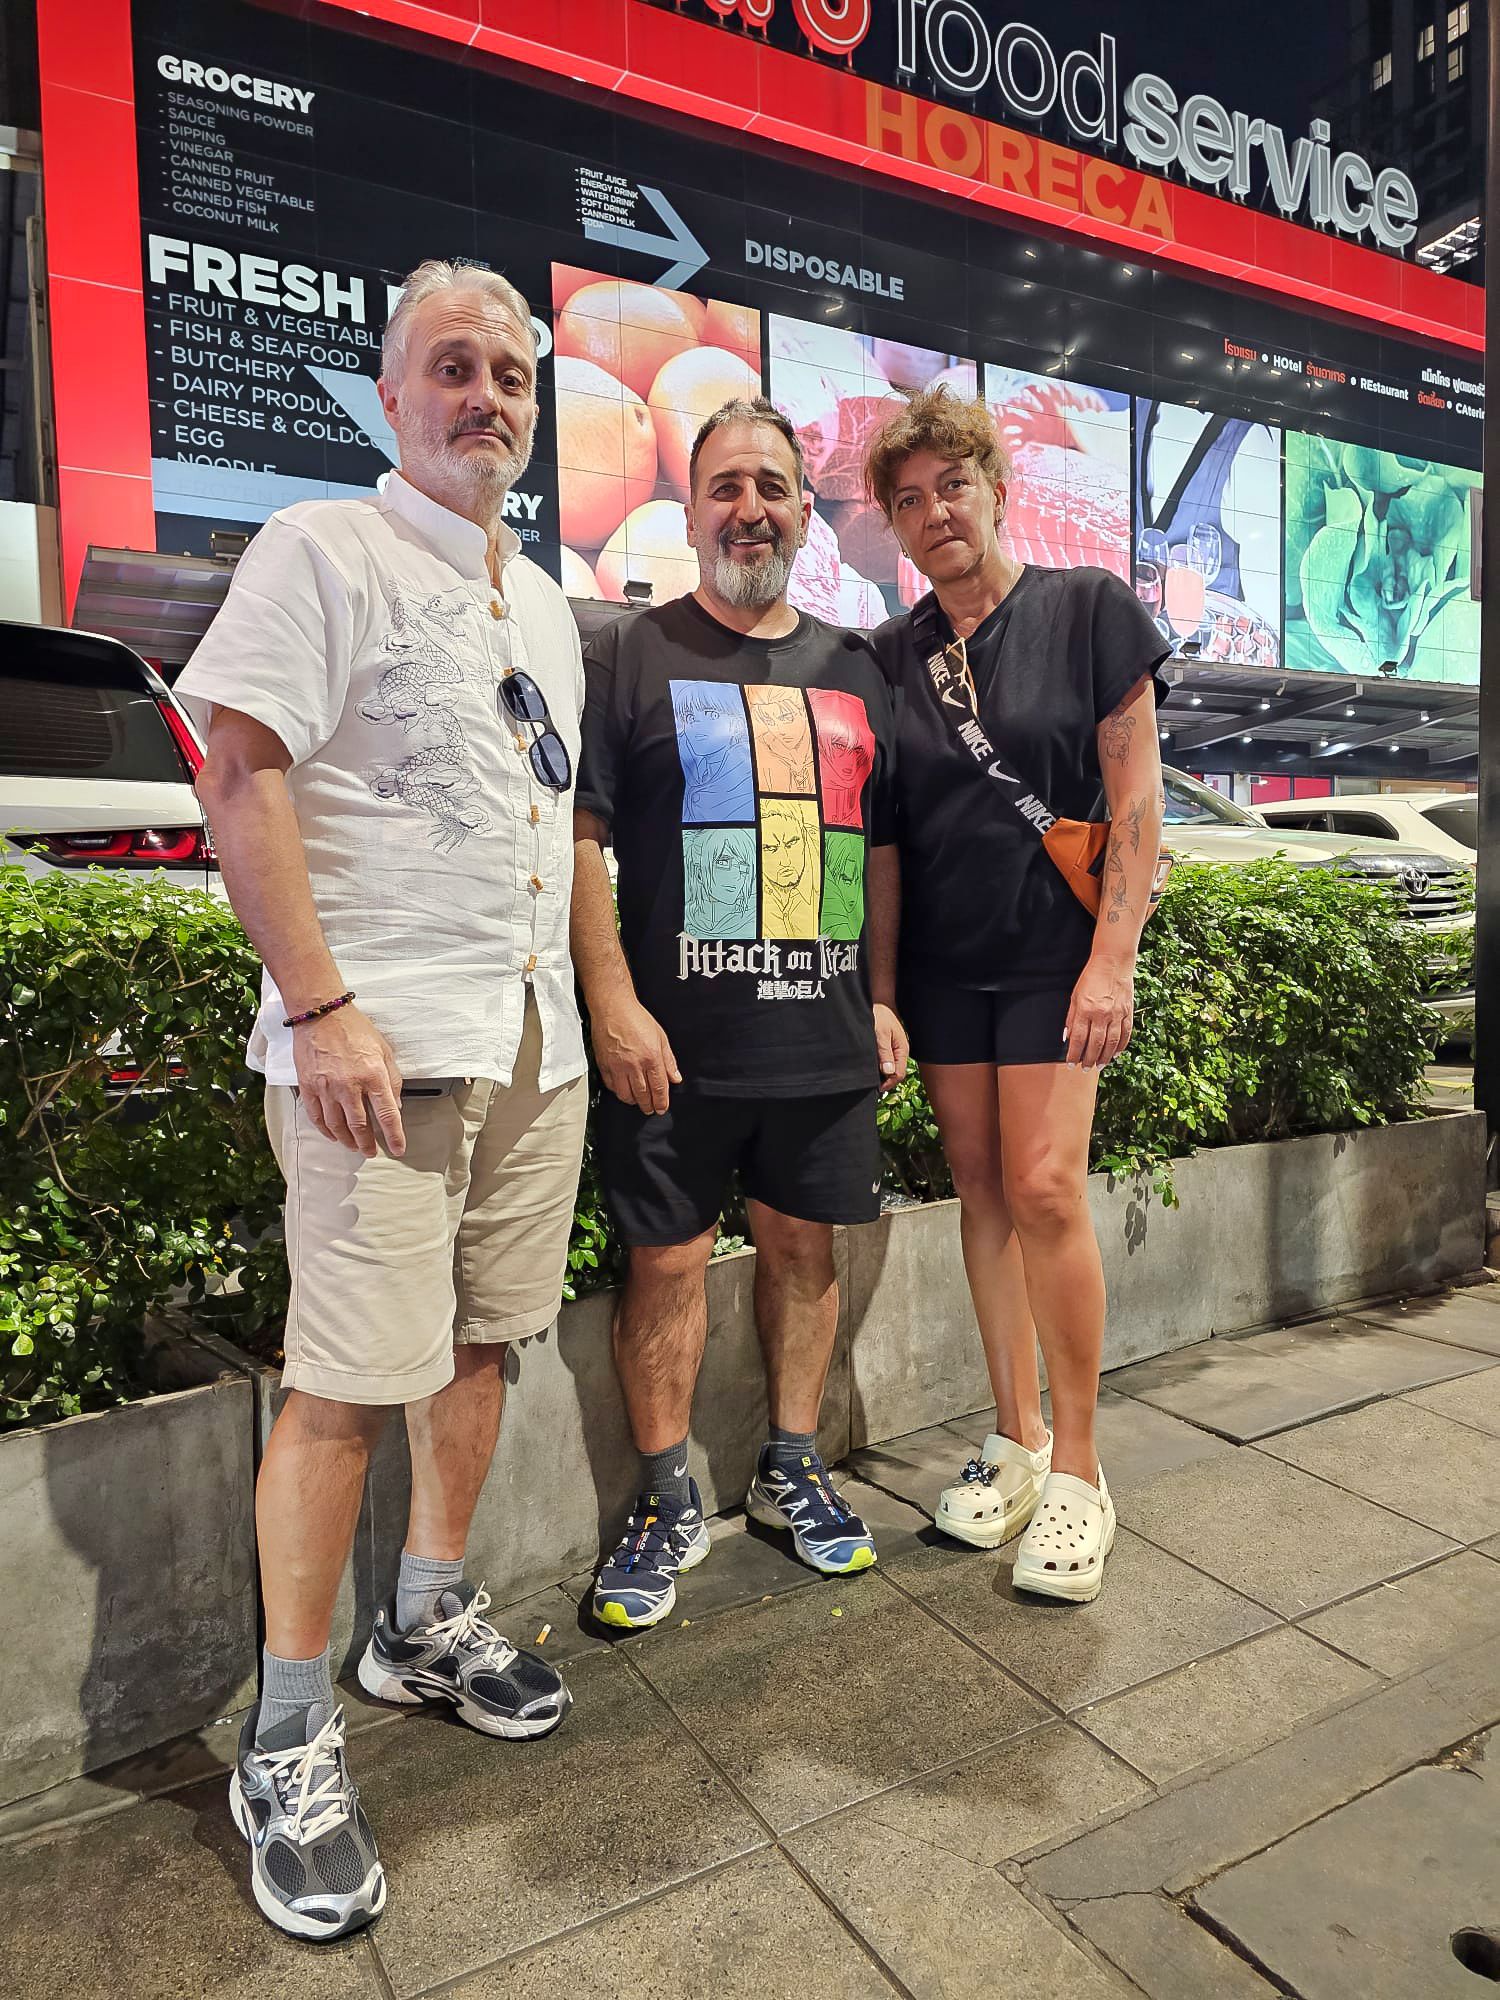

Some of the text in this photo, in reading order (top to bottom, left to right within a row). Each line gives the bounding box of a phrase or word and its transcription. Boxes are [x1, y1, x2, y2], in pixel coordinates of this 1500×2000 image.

[157, 54, 316, 114] GROCERY
[167, 92, 314, 137] SEASONING POWDER
[168, 107, 217, 129] SAUCE
[169, 123, 227, 146] DIPPING
[170, 138, 234, 163] VINEGAR
[170, 154, 275, 187] CANNED FRUIT
[580, 168, 627, 187] FRUIT JUICE
[865, 79, 1175, 242] HORECA
[1123, 72, 1419, 248] service
[171, 170, 315, 212] CANNED VEGETABLE
[172, 185, 268, 216] CANNED FISH
[580, 177, 638, 199] ENERGY DRINK
[580, 187, 634, 208] WATER DRINK
[581, 198, 628, 216] SOFT DRINK
[172, 201, 281, 234] COCONUT MILK
[581, 207, 636, 228] CANNED MILK
[148, 233, 367, 325] FRESH
[745, 239, 905, 301] DISPOSABLE
[168, 293, 237, 321] FRUIT
[243, 307, 260, 327] &
[265, 311, 384, 351] VEGETABL
[169, 319, 360, 370] FISH & SEAFOOD
[171, 345, 296, 384] BUTCHERY
[1223, 337, 1257, 361] โรงแรม
[1273, 354, 1302, 374] HOtel
[1360, 376, 1409, 401] REstaurant
[172, 372, 348, 419] DAIRY PRODUC
[173, 399, 266, 431] CHEESE
[271, 415, 287, 434] &
[174, 424, 226, 449] EGG
[927, 650, 951, 690] NIKE
[956, 717, 995, 762] NIKE
[1013, 792, 1058, 836] NIKE
[675, 930, 783, 981] Attack
[785, 948, 813, 971] on
[757, 979, 826, 1001] 進撃の巨人
